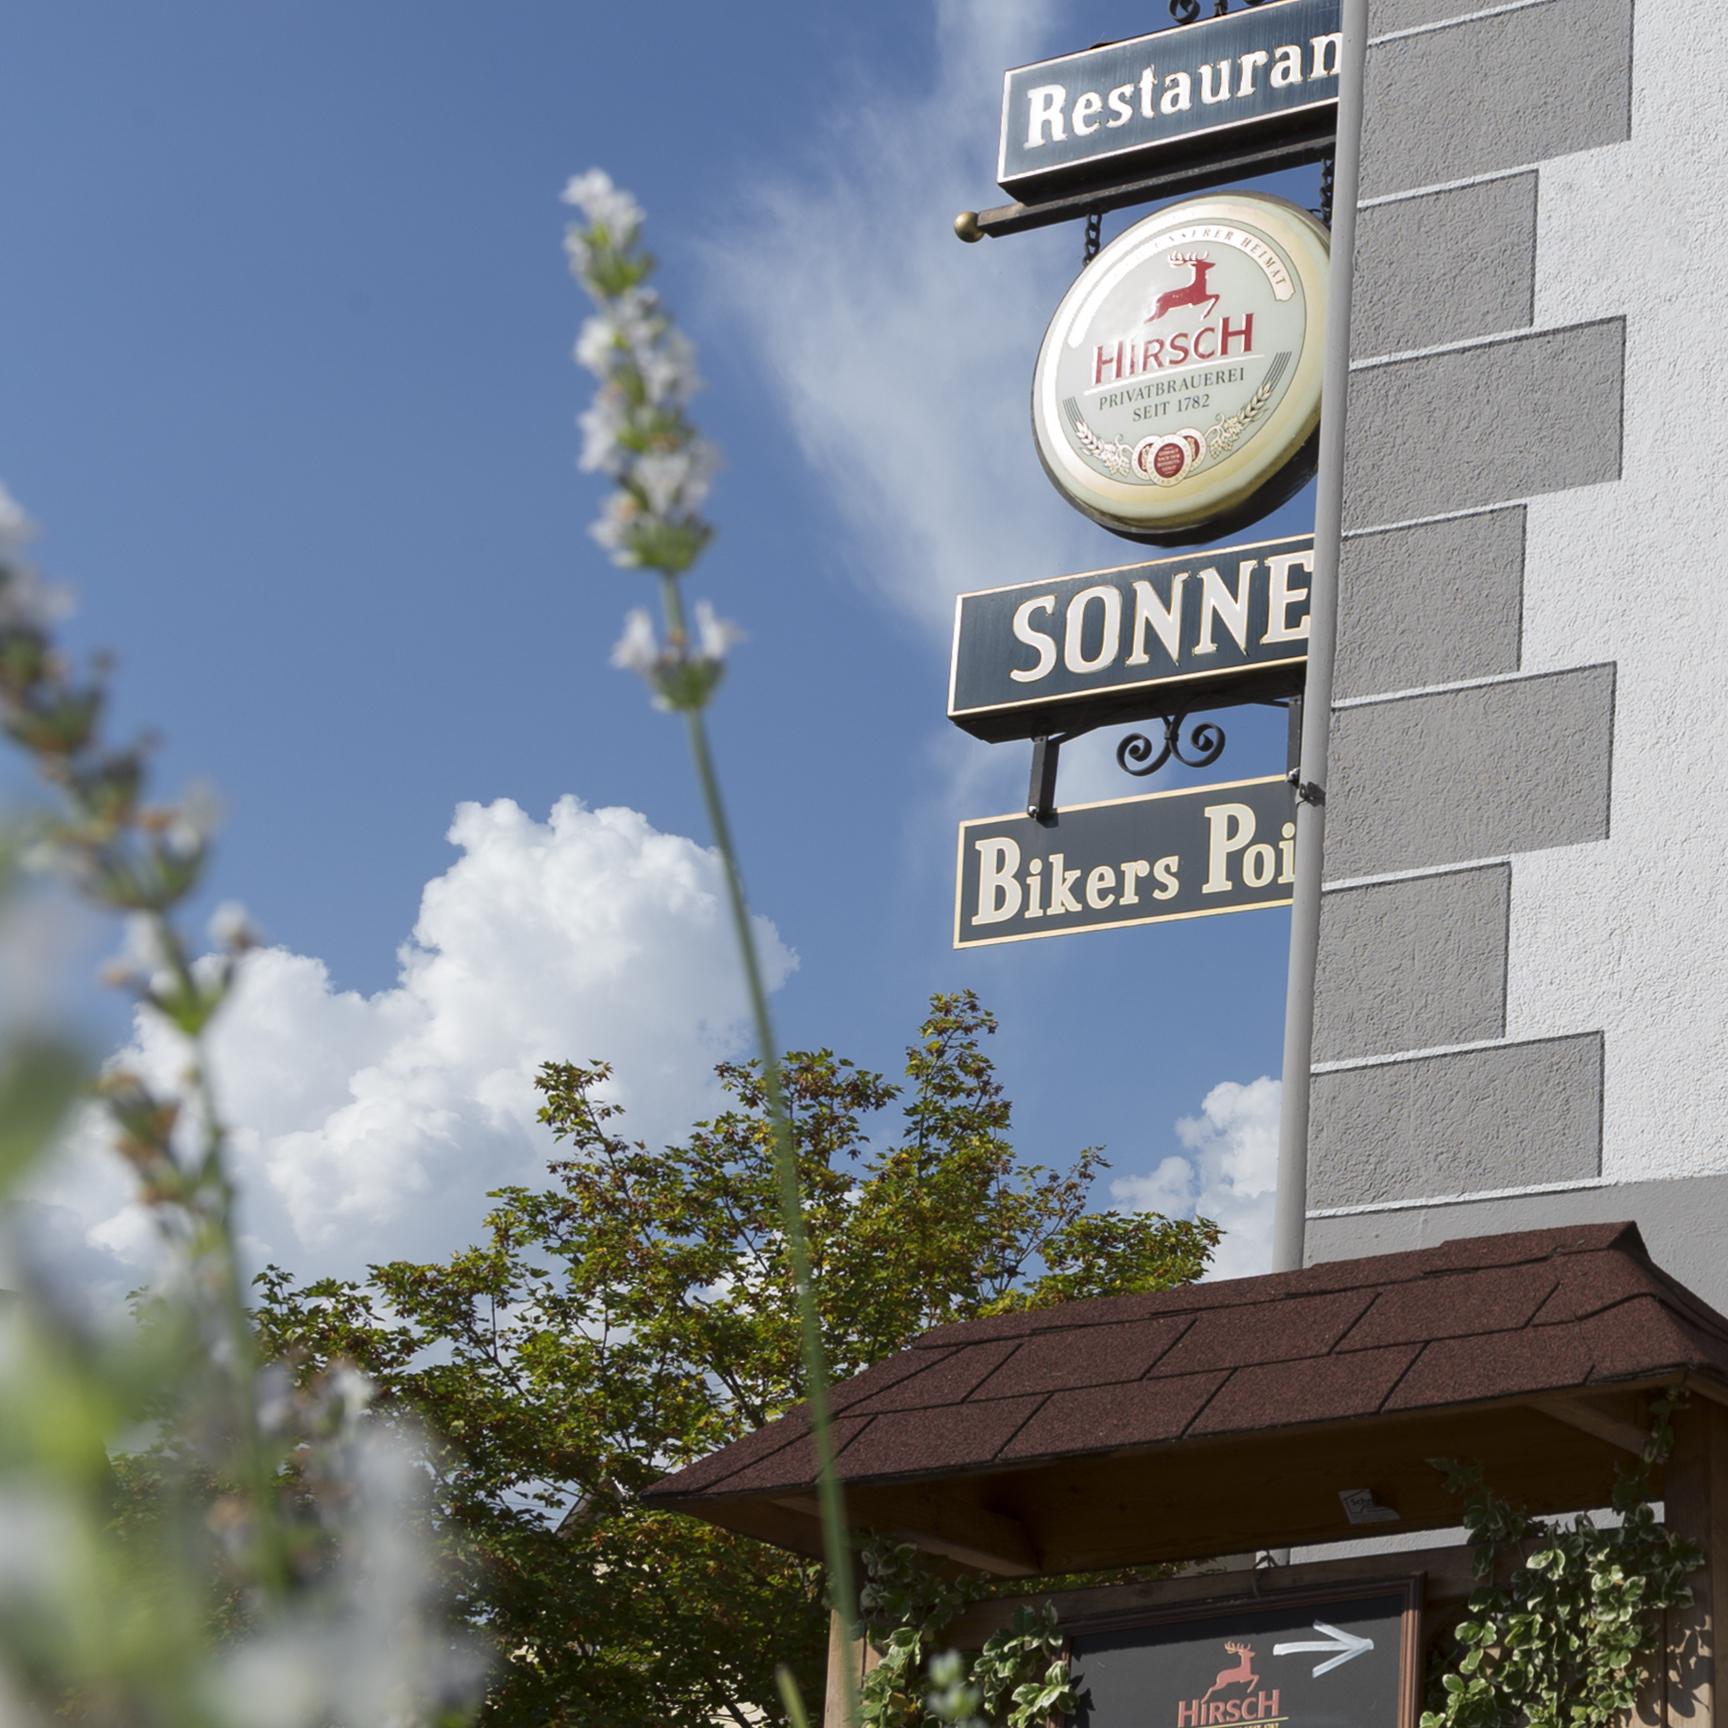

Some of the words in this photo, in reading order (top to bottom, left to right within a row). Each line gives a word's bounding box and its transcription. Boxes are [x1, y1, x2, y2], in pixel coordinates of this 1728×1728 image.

[1239, 235, 1287, 286] HEIMAT
[1093, 312, 1255, 386] HIRSCH
[1098, 367, 1245, 411] PRIVATBRAUEREI
[1131, 401, 1170, 423] SEIT
[1176, 393, 1211, 414] 1782
[1010, 550, 1313, 682] SONNE
[971, 836, 1180, 927] Bikers
[1177, 1689, 1280, 1728] HIRSCH
